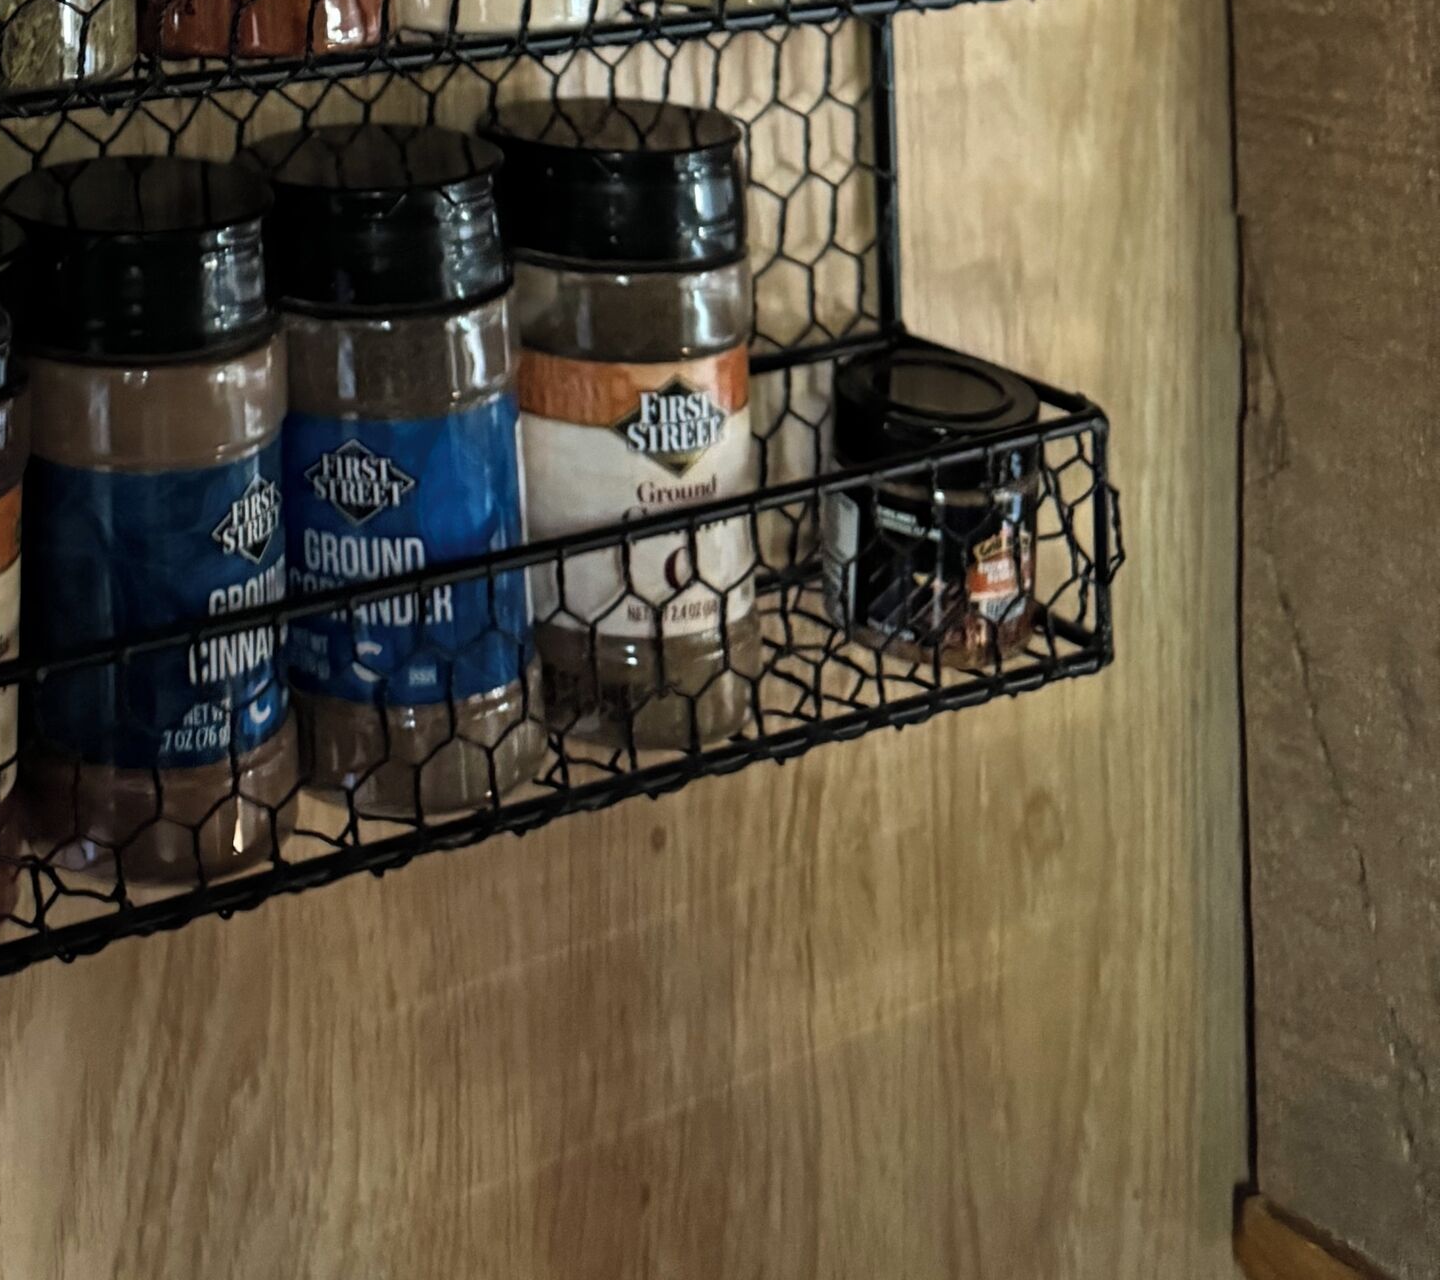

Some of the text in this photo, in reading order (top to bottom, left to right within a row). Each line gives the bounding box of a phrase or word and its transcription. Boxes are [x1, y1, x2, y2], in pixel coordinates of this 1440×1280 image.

[639, 390, 711, 427] FIRST
[626, 410, 722, 453] STREET
[321, 452, 392, 483] FIRST
[231, 479, 277, 526] FIRST
[313, 474, 401, 507] STREET
[636, 473, 718, 505] Ground
[221, 505, 279, 555] STREET
[303, 527, 426, 579] GROUND
[671, 601, 702, 622] 2.4 OZ
[183, 704, 210, 727] NET
[174, 730, 194, 752] OZ
